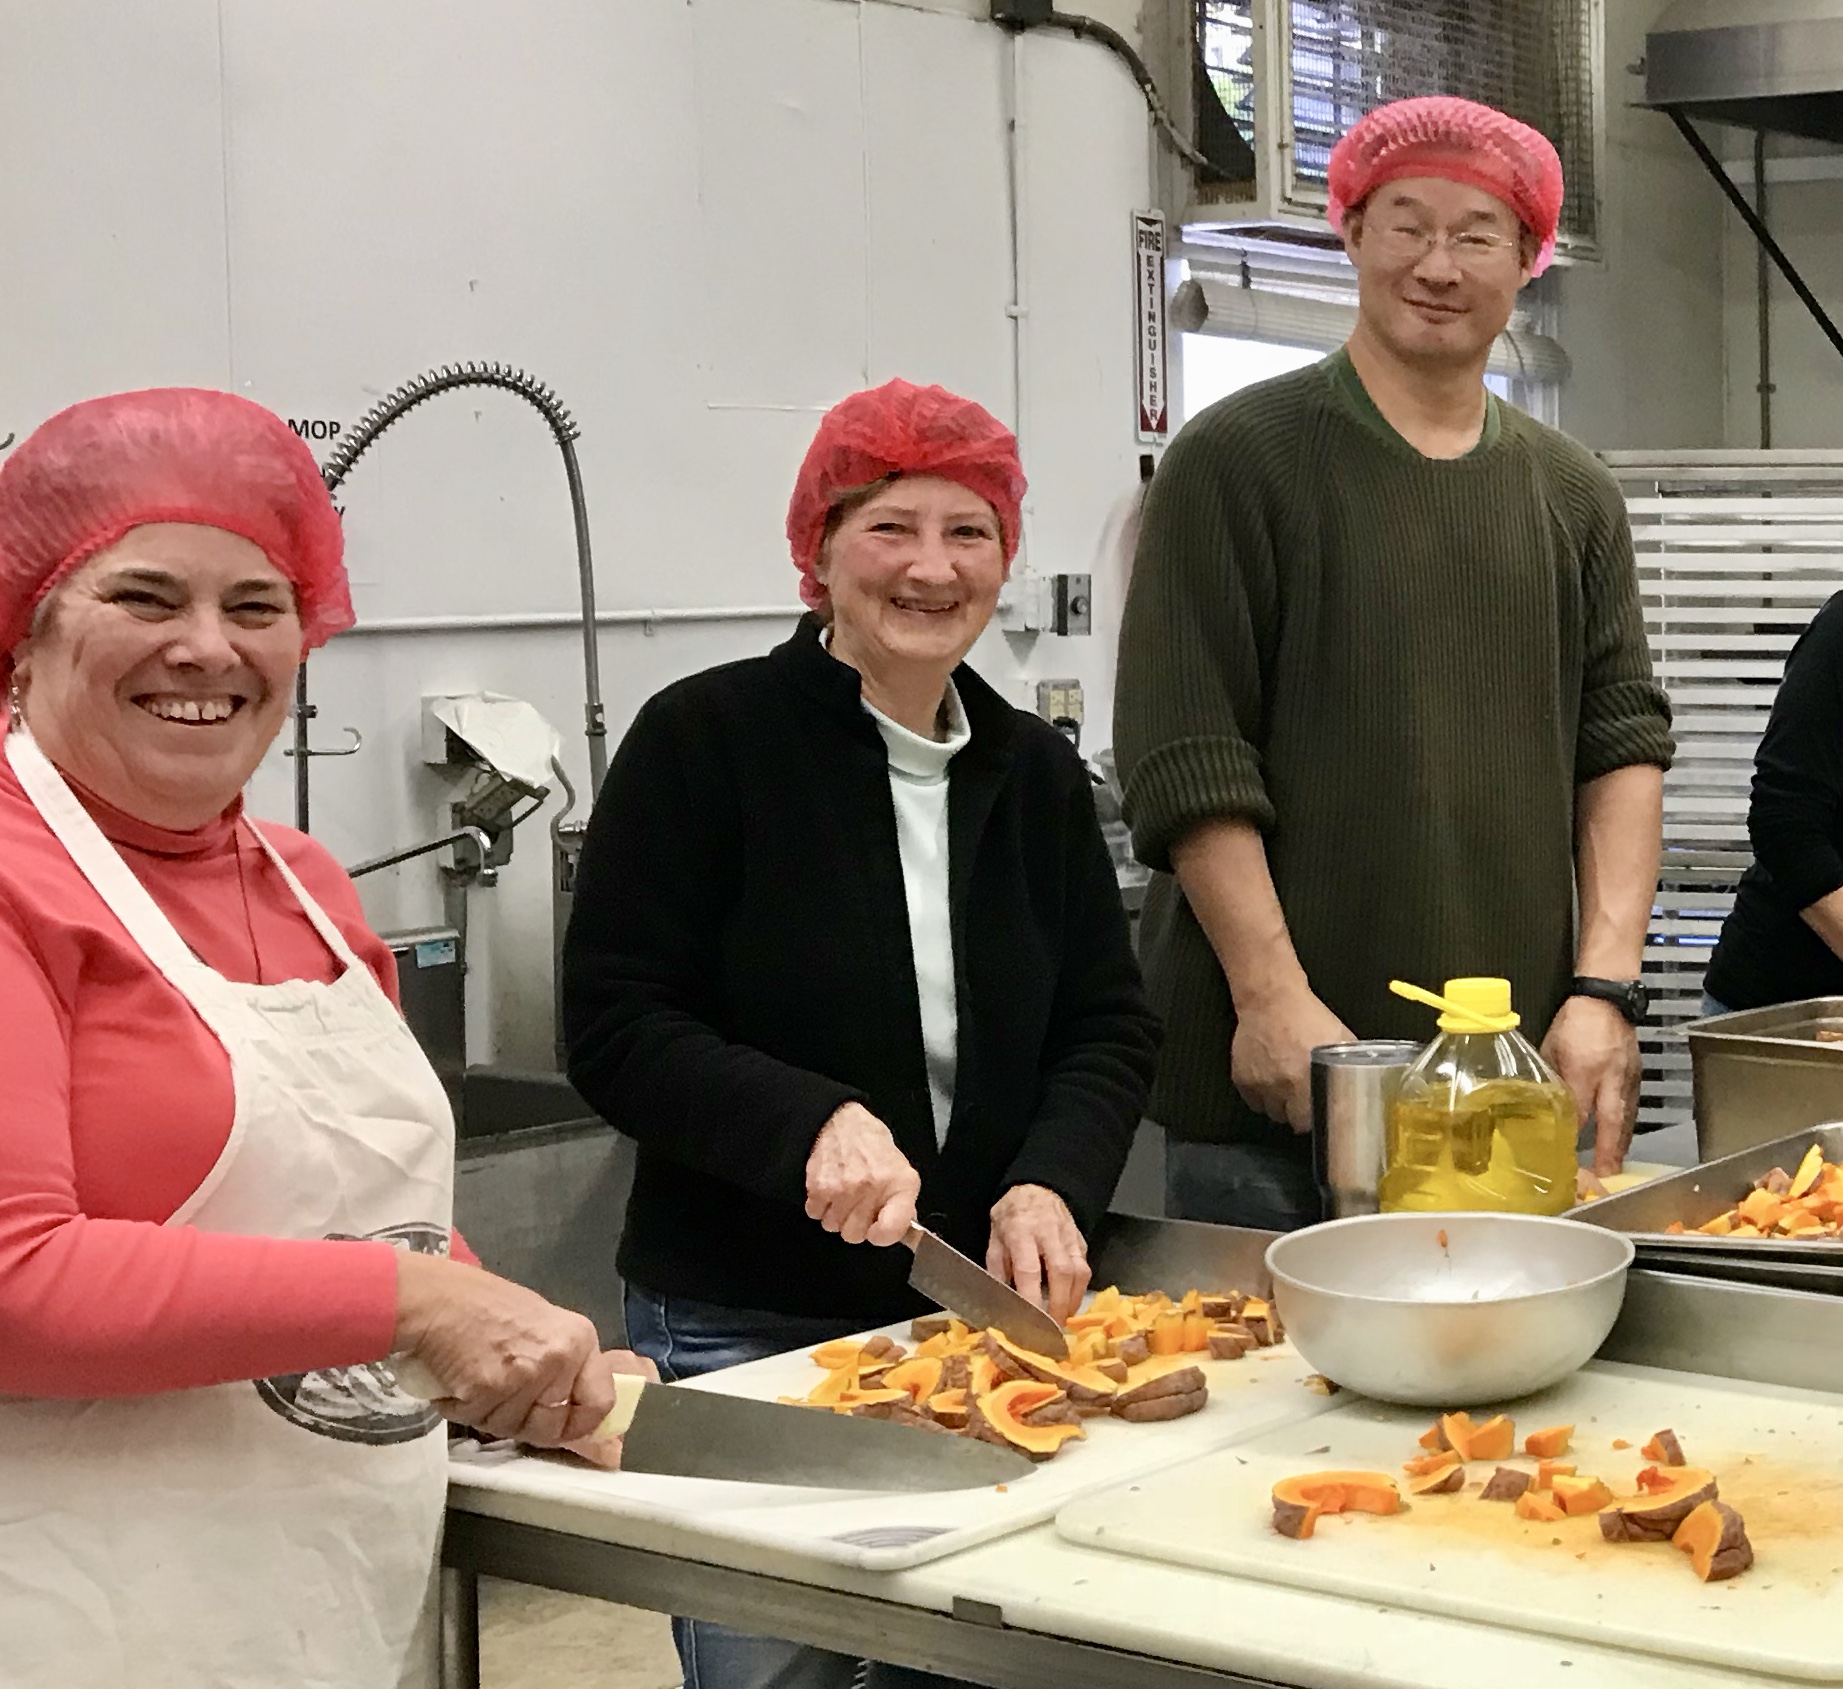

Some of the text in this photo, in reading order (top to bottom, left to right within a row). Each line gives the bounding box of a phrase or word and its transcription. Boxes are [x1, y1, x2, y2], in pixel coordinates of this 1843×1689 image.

[1138, 228, 1161, 251] FIRE
[1146, 254, 1158, 421] EXTINGUISHER
[287, 418, 342, 440] MOP
